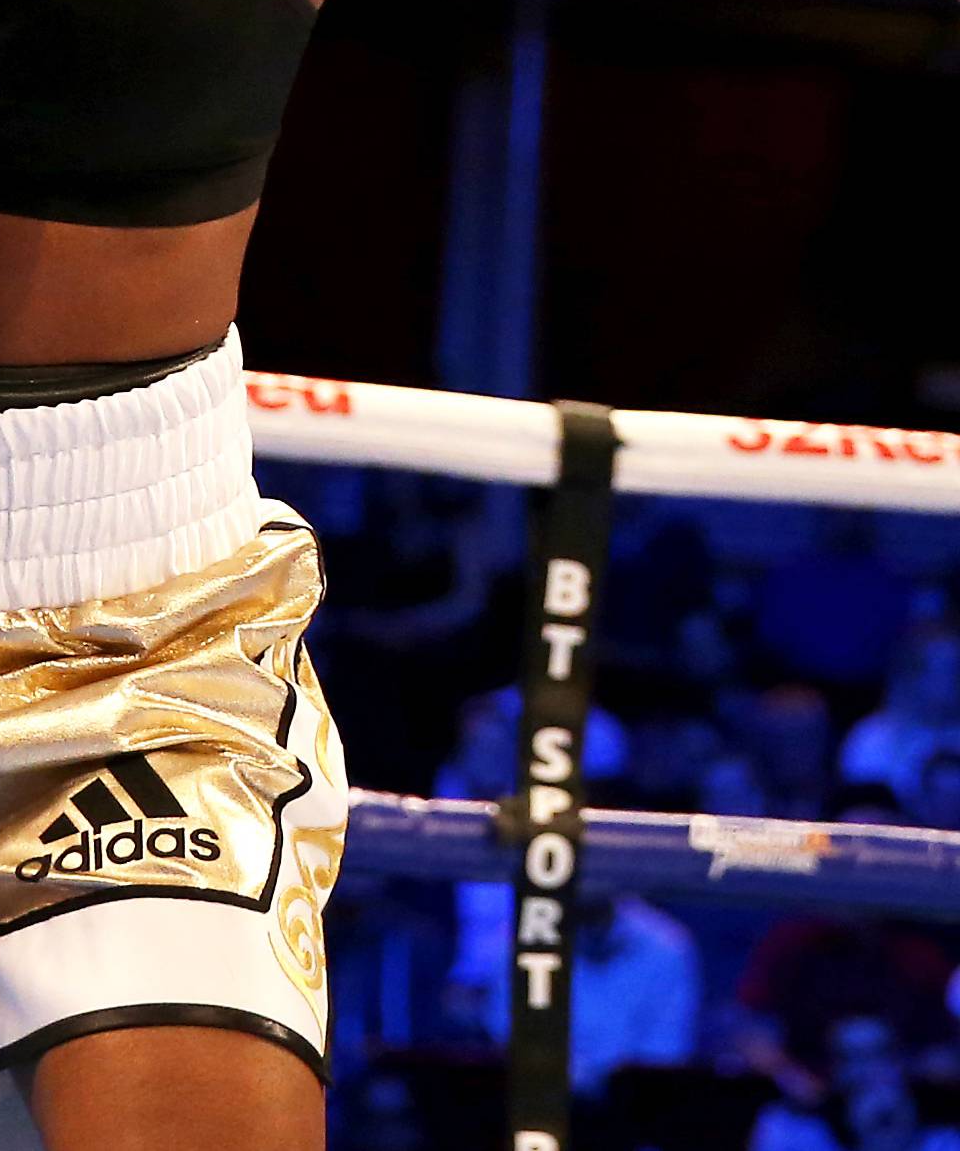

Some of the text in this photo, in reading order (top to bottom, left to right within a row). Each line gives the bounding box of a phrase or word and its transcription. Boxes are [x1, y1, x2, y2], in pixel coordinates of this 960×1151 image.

[14, 818, 221, 883] adidas
[517, 556, 591, 1010] BT SPORT
